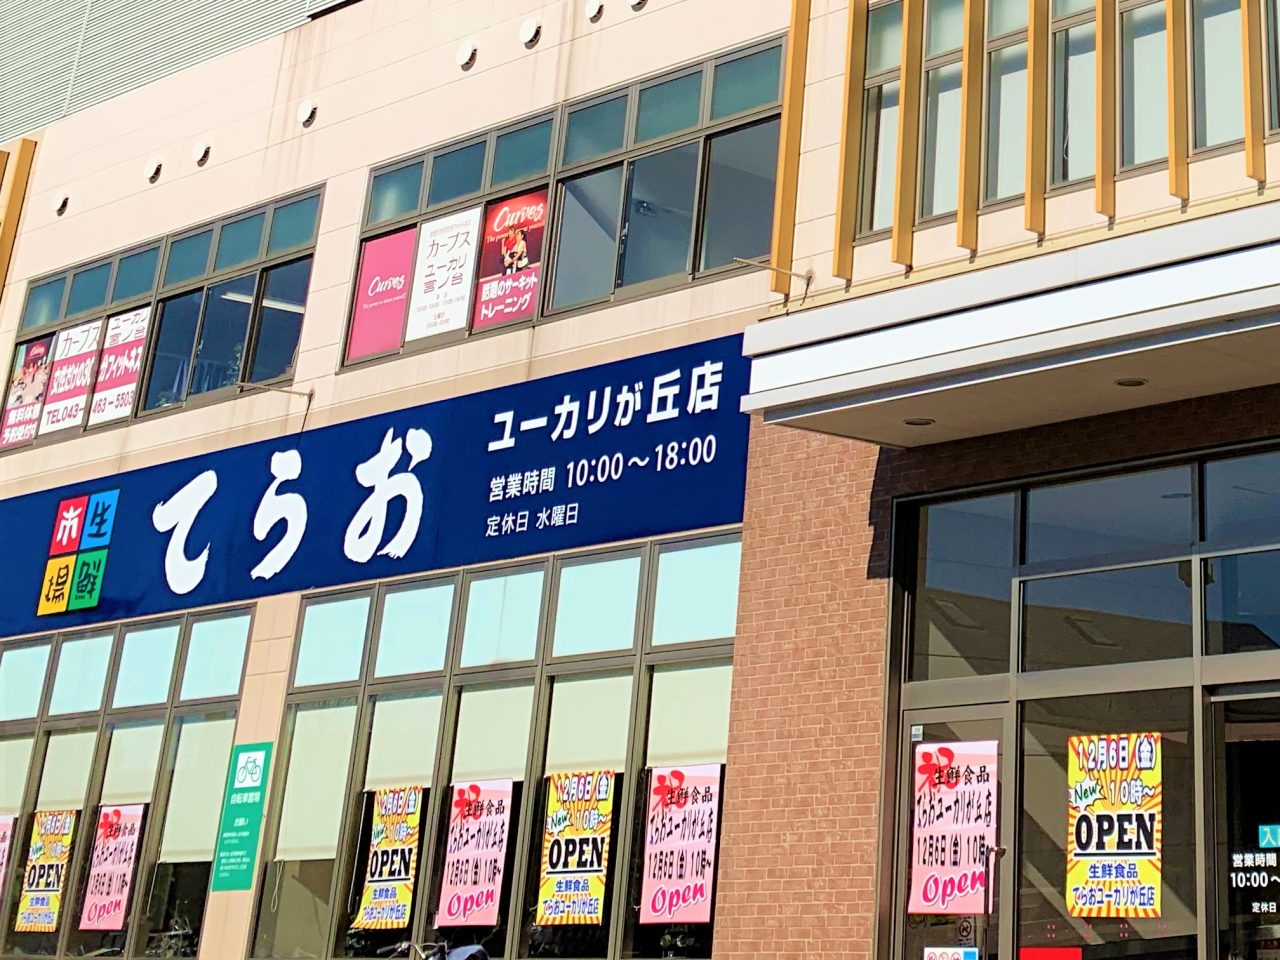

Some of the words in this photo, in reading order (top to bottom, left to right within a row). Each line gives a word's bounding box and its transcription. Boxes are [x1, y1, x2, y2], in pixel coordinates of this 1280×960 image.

[493, 202, 545, 232] Curves
[424, 253, 468, 278] ユーカリ
[367, 274, 405, 297] Curves
[423, 271, 464, 294] 宮ノ台
[480, 292, 532, 321] トレーニング
[488, 360, 723, 452] ユーカリが丘店
[489, 466, 556, 503] 営業時間
[152, 427, 433, 595] てらお
[485, 510, 529, 538] 定休日
[535, 502, 579, 530] 水曜日
[934, 765, 991, 786] 生鮮食品
[666, 785, 714, 807] 生鮮食品
[1074, 782, 1098, 805] New
[465, 799, 505, 818] 生鮮食品
[916, 788, 992, 828] てらおユーカリが丘店
[550, 812, 568, 830] New
[1075, 813, 1156, 851] OPEN
[369, 847, 413, 879] OPEN
[548, 837, 606, 870] OPEN
[1232, 853, 1277, 868] 営業時間
[27, 863, 64, 889] OPEN
[1088, 863, 1138, 879] 生鮮食品
[372, 887, 397, 900] 生鮮食品
[555, 878, 590, 893] 生鮮食品
[922, 870, 985, 906] Open
[1072, 886, 1155, 907] てらおユーカリが丘店
[87, 898, 122, 924] Open
[447, 888, 495, 920] Open
[542, 897, 600, 917] てらおユーカリが丘店
[651, 881, 706, 916] Open
[1251, 901, 1277, 913] 定休日
